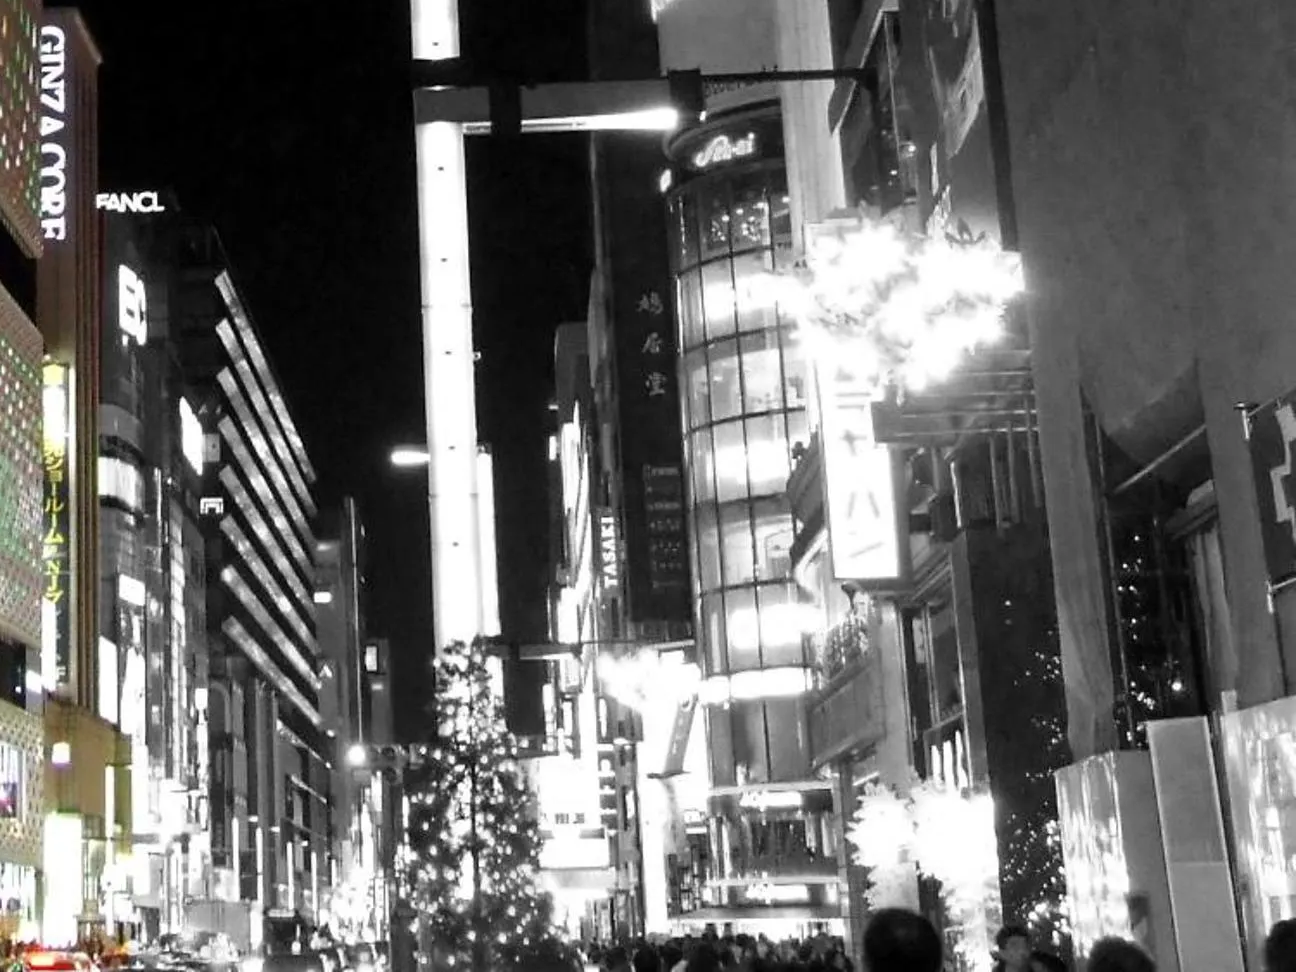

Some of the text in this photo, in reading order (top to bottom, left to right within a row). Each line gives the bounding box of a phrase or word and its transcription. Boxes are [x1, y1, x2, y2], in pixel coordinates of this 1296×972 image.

[40, 25, 67, 241] GINZA CORE
[95, 191, 165, 213] FANCL
[600, 516, 619, 590] TASAKI
